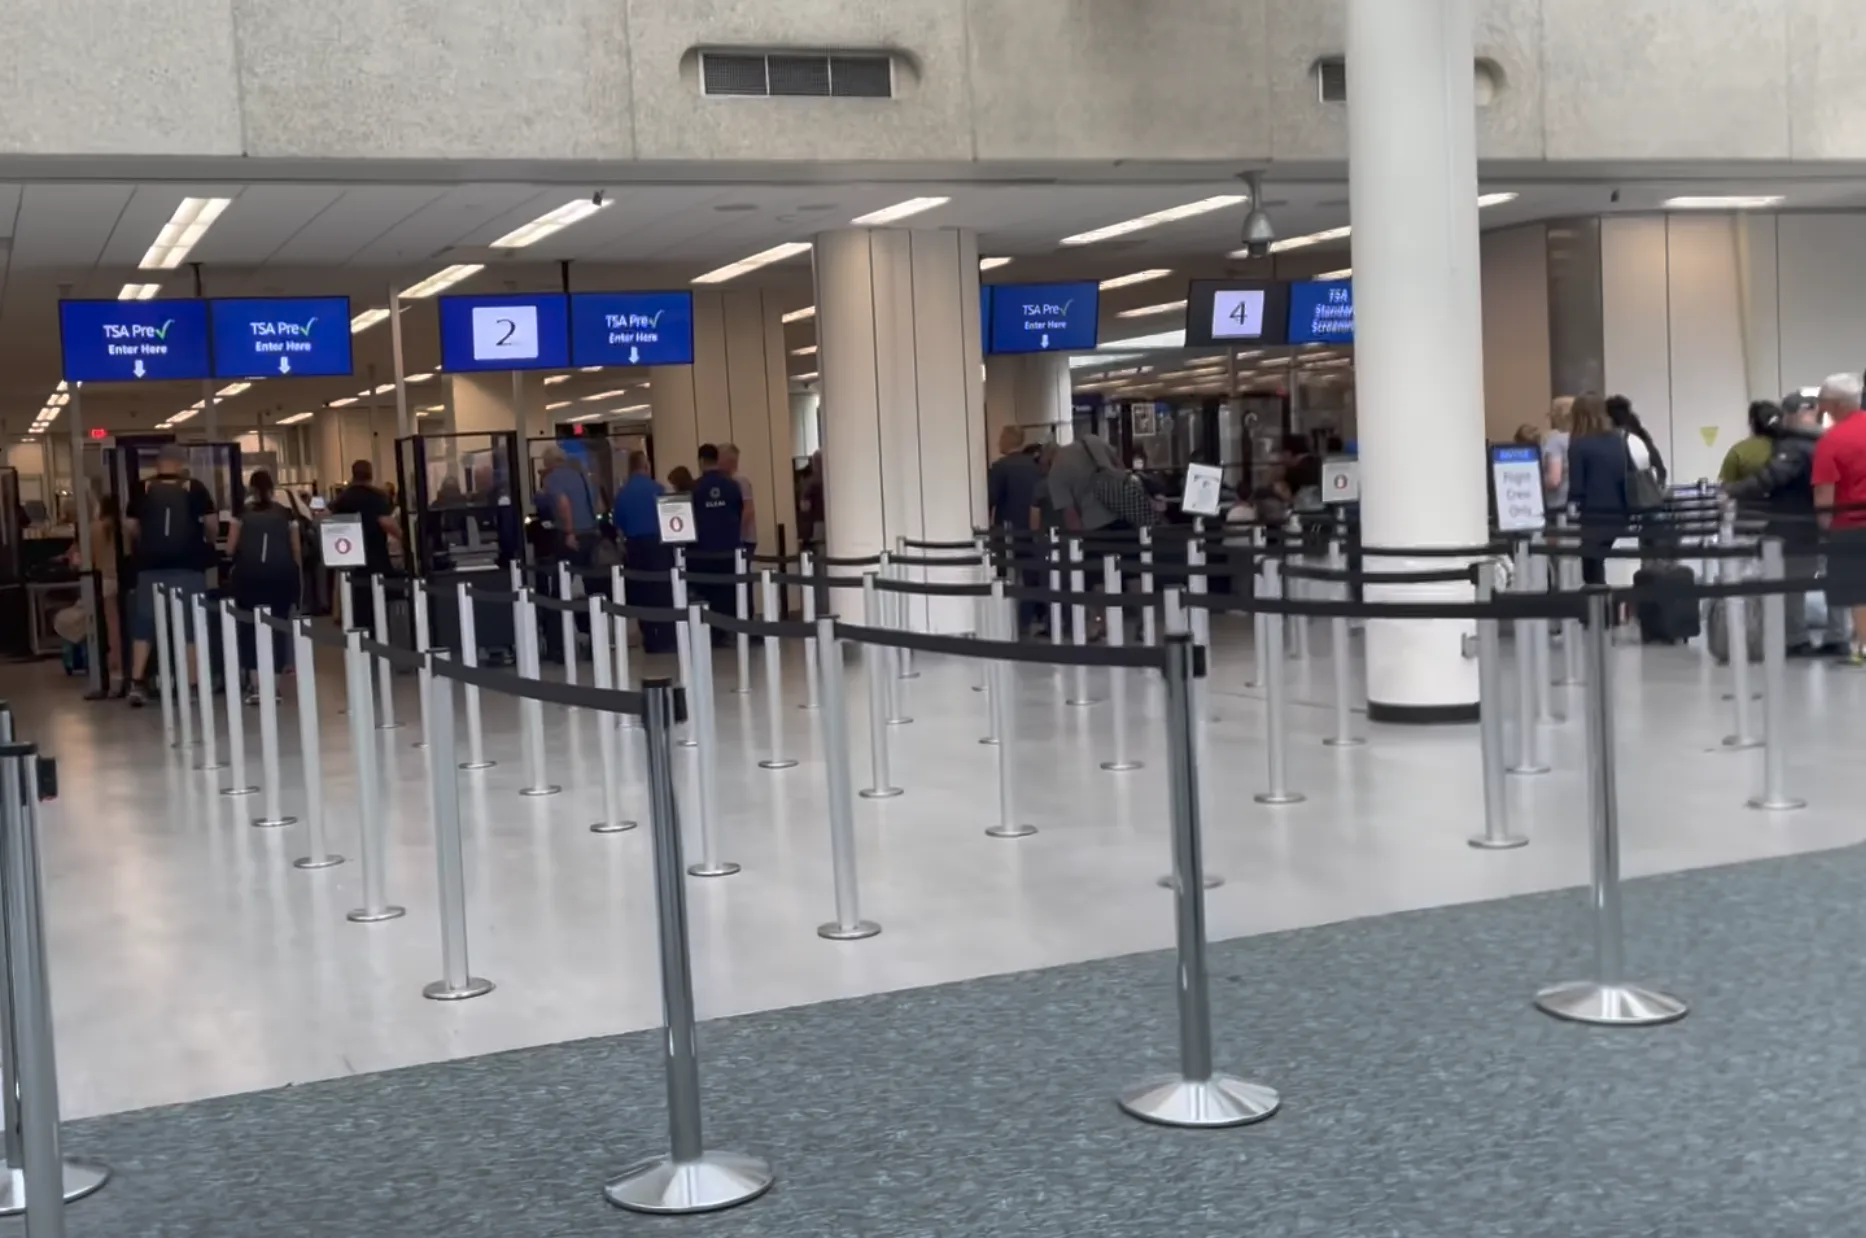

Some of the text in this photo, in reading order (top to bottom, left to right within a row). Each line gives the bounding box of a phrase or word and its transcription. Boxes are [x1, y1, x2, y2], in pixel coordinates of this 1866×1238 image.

[1022, 303, 1060, 316] TSA Pre
[1229, 300, 1248, 326] 4
[1315, 304, 1354, 318] Standar
[250, 321, 300, 335] TSA Pre
[605, 314, 628, 328] TSA
[1024, 320, 1067, 330] Enter Here
[102, 324, 155, 338] TSA Pre
[495, 318, 517, 347] 2
[609, 332, 658, 344] Enter Here
[108, 344, 168, 355] Enter Here
[255, 340, 312, 352] Enter Here
